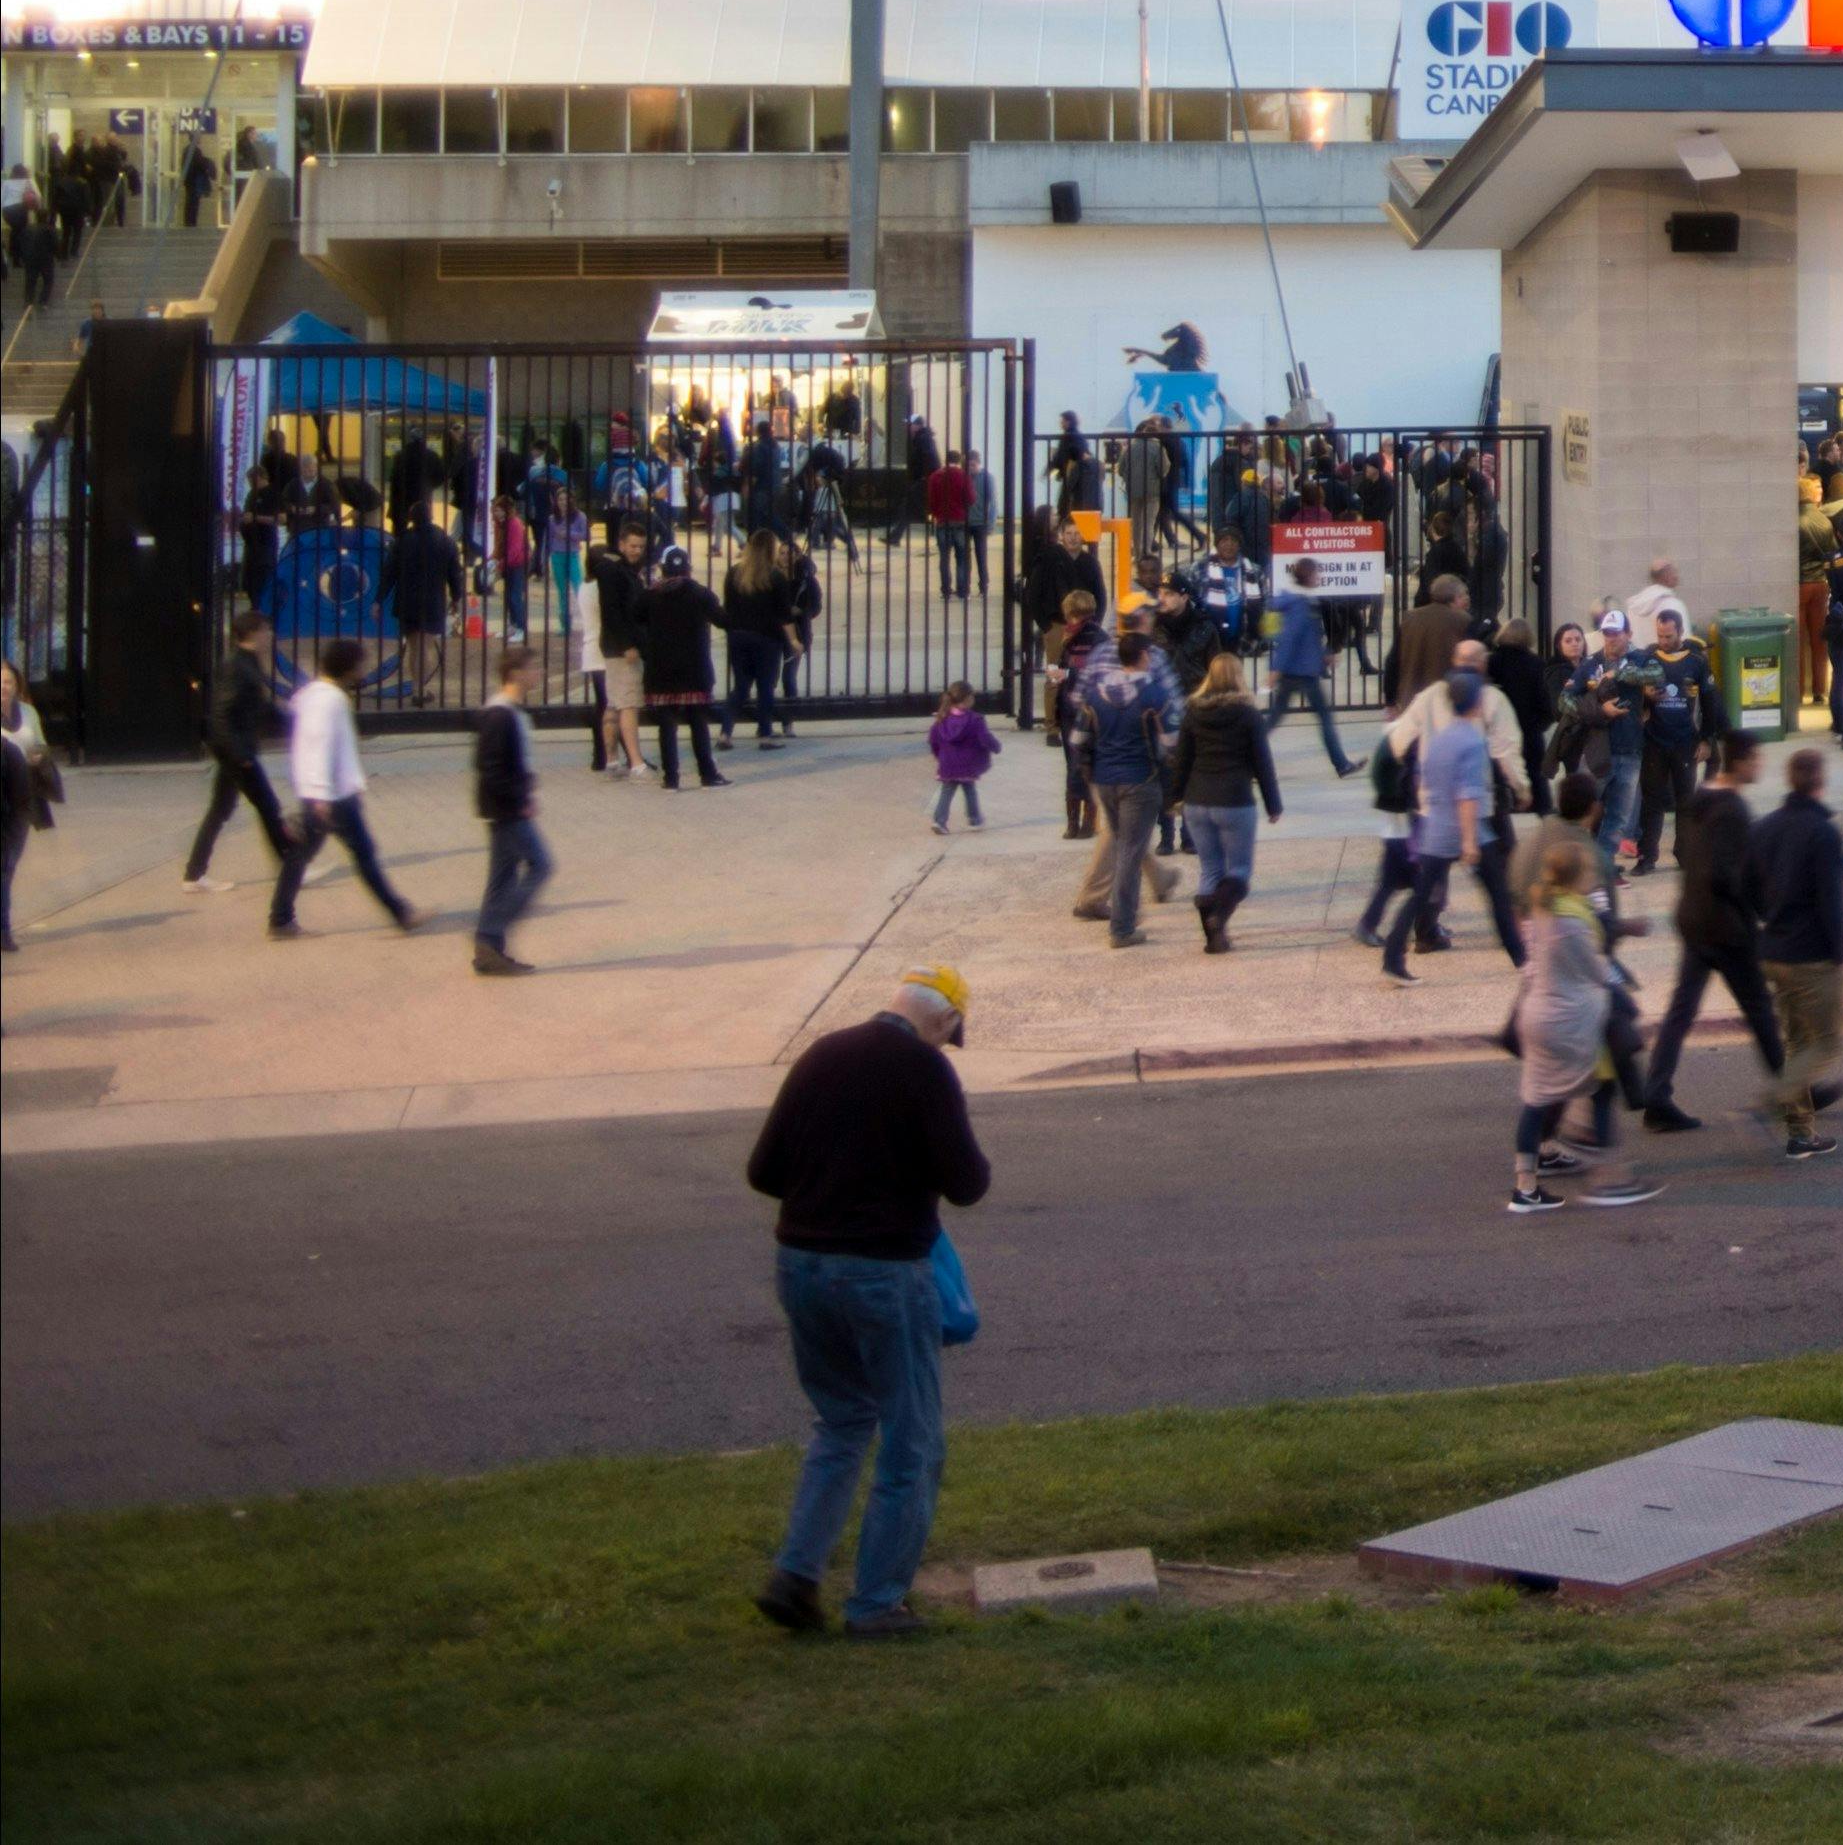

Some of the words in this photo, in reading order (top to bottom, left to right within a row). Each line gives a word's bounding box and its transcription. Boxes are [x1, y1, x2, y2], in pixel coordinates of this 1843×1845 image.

[32, 25, 116, 45] BOXES
[124, 25, 142, 44] &
[147, 24, 209, 44] BAYS
[218, 25, 245, 44] 11
[276, 24, 305, 44] 15
[1426, 1, 1572, 57] GIO
[1426, 63, 1526, 90] STADI
[1426, 94, 1500, 115] CANB
[1285, 527, 1302, 538] ALL
[1304, 525, 1373, 537] CONTRACTORS
[1302, 539, 1311, 550] &
[1313, 538, 1356, 549] VISITORS
[1346, 562, 1357, 572] IN
[1360, 561, 1372, 571] AT
[1320, 576, 1358, 587] EPTION
